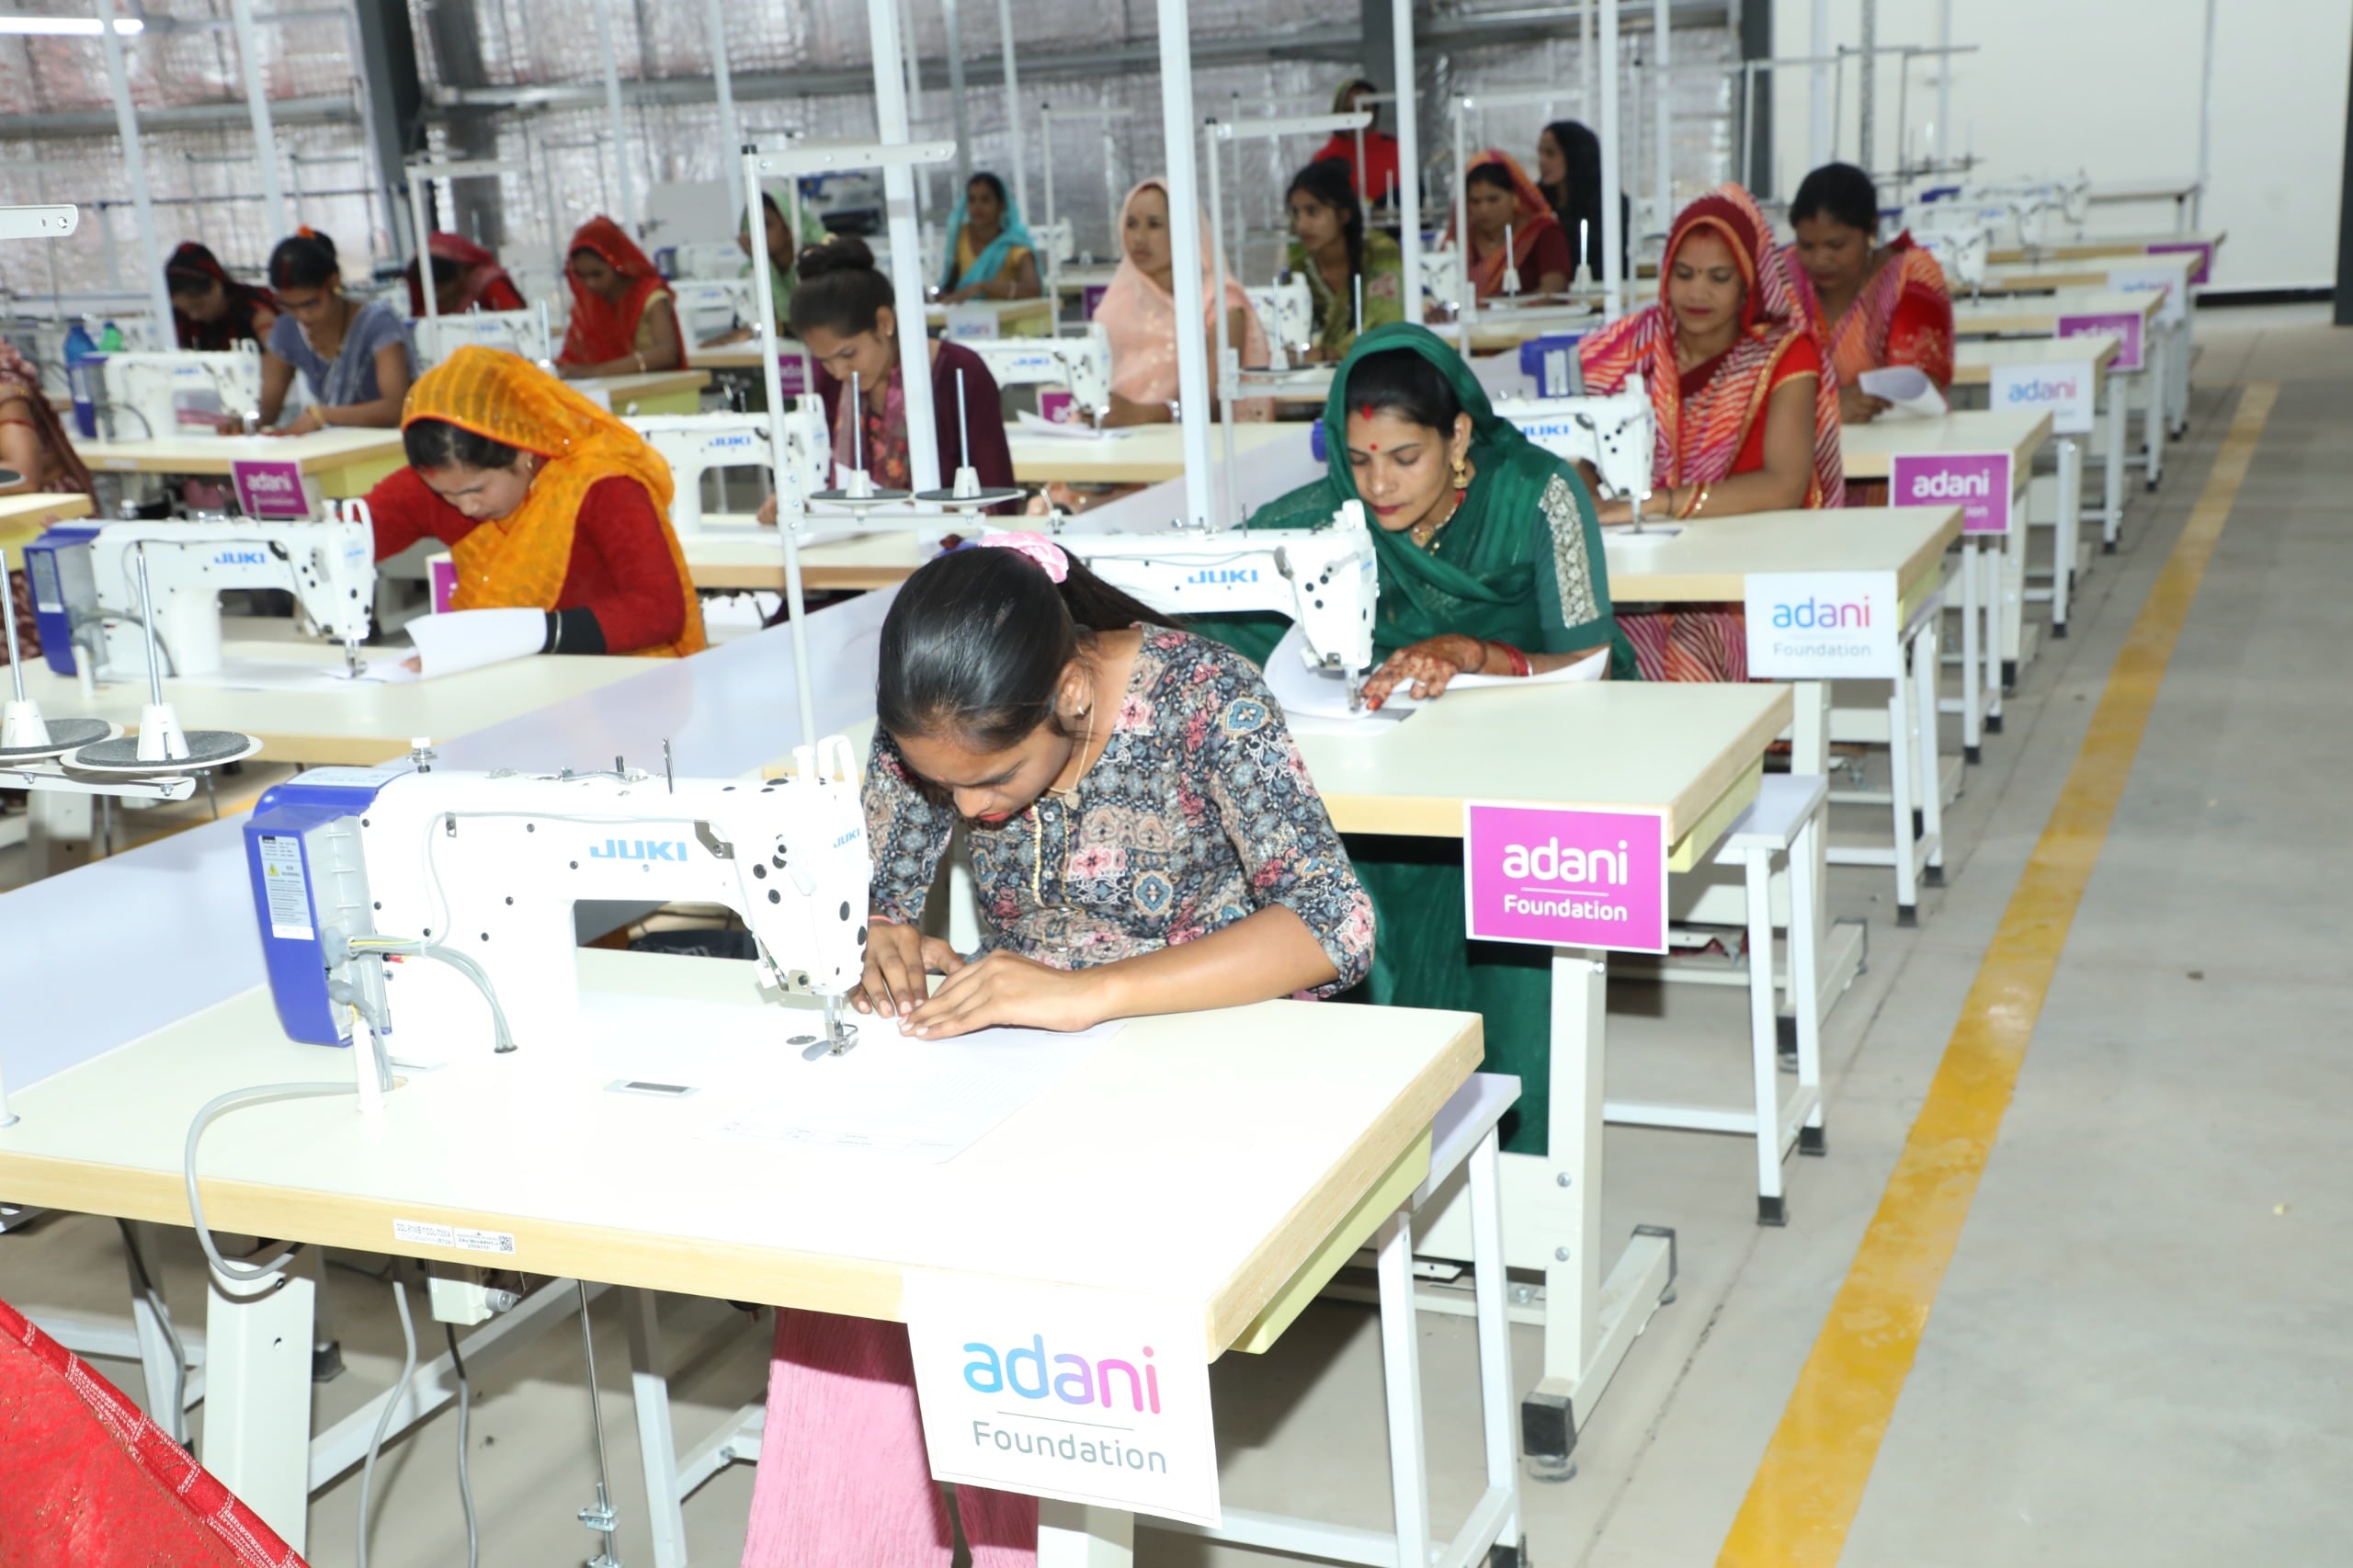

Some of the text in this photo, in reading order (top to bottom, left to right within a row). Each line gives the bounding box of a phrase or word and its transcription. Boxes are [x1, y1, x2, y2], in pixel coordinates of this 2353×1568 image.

[2007, 376, 2077, 403] adani
[1912, 468, 1990, 498] adani
[214, 552, 266, 564] JUKI
[1188, 569, 1258, 584] JUKI
[1772, 595, 1870, 629] adani
[1773, 642, 1871, 657] Foundation
[589, 839, 688, 861] JUKI
[833, 827, 860, 849] JUKI
[1502, 836, 1628, 885] adani
[1504, 894, 1628, 922] Foundation
[962, 1334, 1161, 1415] adani
[972, 1420, 1167, 1474] Foundation
